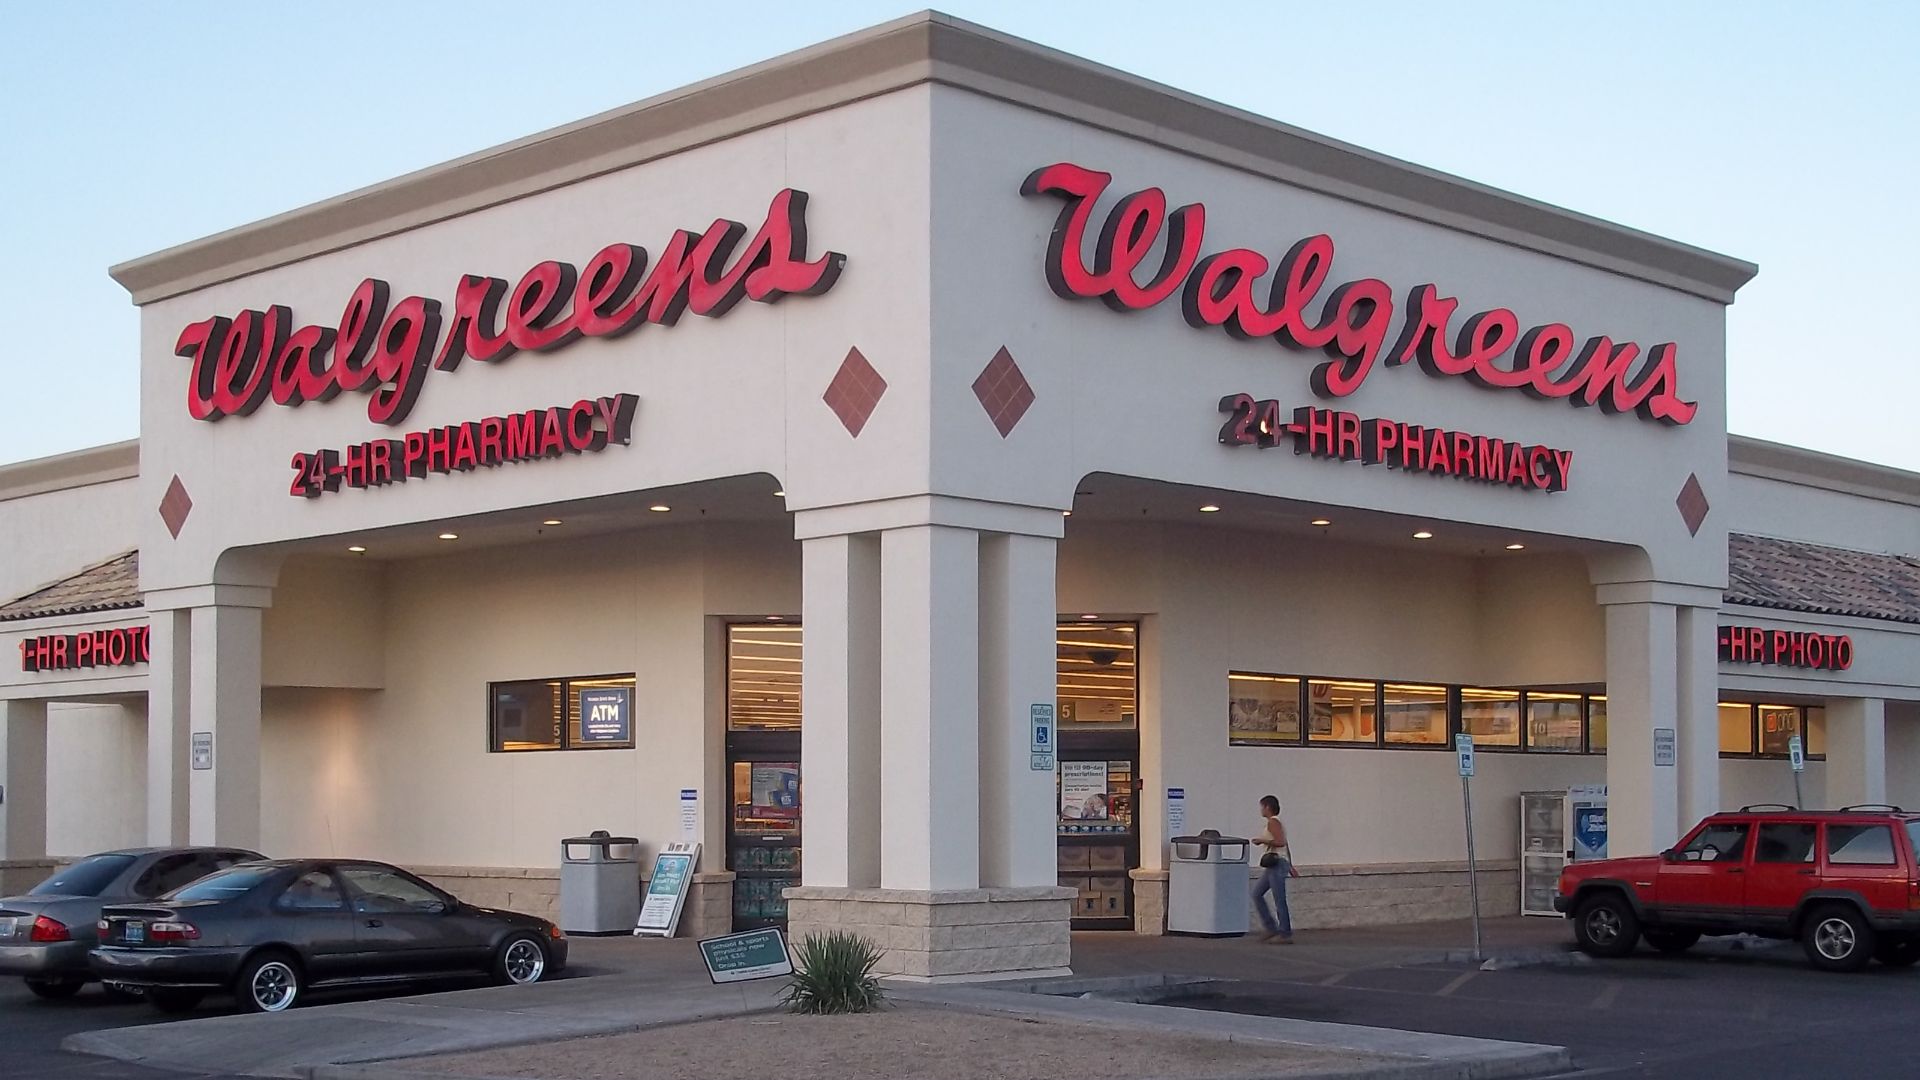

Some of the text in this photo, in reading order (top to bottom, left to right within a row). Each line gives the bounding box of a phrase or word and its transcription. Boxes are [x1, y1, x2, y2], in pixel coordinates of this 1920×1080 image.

[174, 188, 846, 426] Walgreens
[1020, 162, 1697, 426] Walgreens
[290, 393, 640, 497] 24-HR PHARMACY
[1219, 392, 1573, 492] 24-HR PHARMACY
[19, 634, 69, 672] 1-HR
[1718, 625, 1854, 671] -HR PHOTO
[590, 704, 619, 721] ATM
[710, 940, 737, 950] School
[746, 936, 770, 945] sports
[713, 946, 748, 957] physicals
